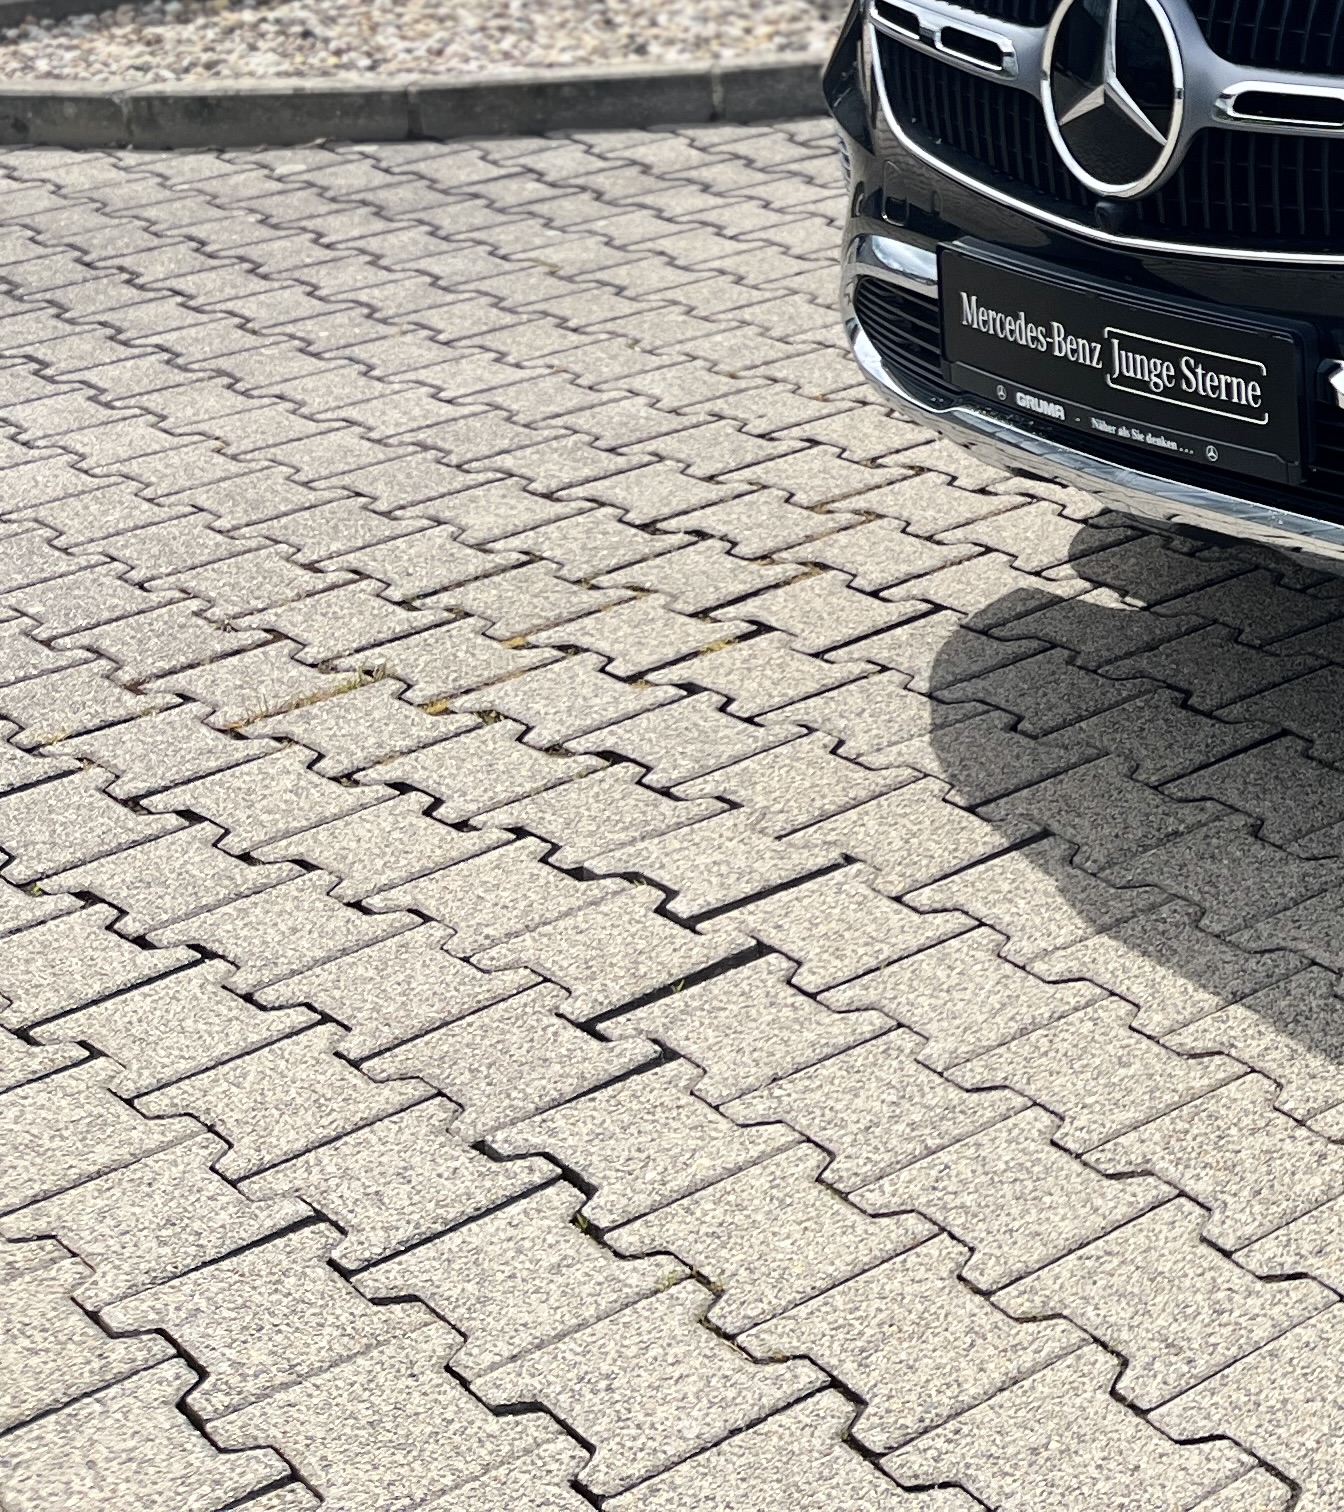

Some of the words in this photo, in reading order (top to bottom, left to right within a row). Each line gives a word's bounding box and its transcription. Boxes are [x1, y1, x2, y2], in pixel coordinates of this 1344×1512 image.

[960, 291, 1103, 369] Mercedes-Benz
[1111, 338, 1176, 393] Junge
[1180, 355, 1263, 409] Sterne
[1015, 391, 1066, 422] GRUMA
[1117, 424, 1131, 439] als
[1131, 428, 1146, 443] Sie
[1145, 432, 1178, 451] denken
